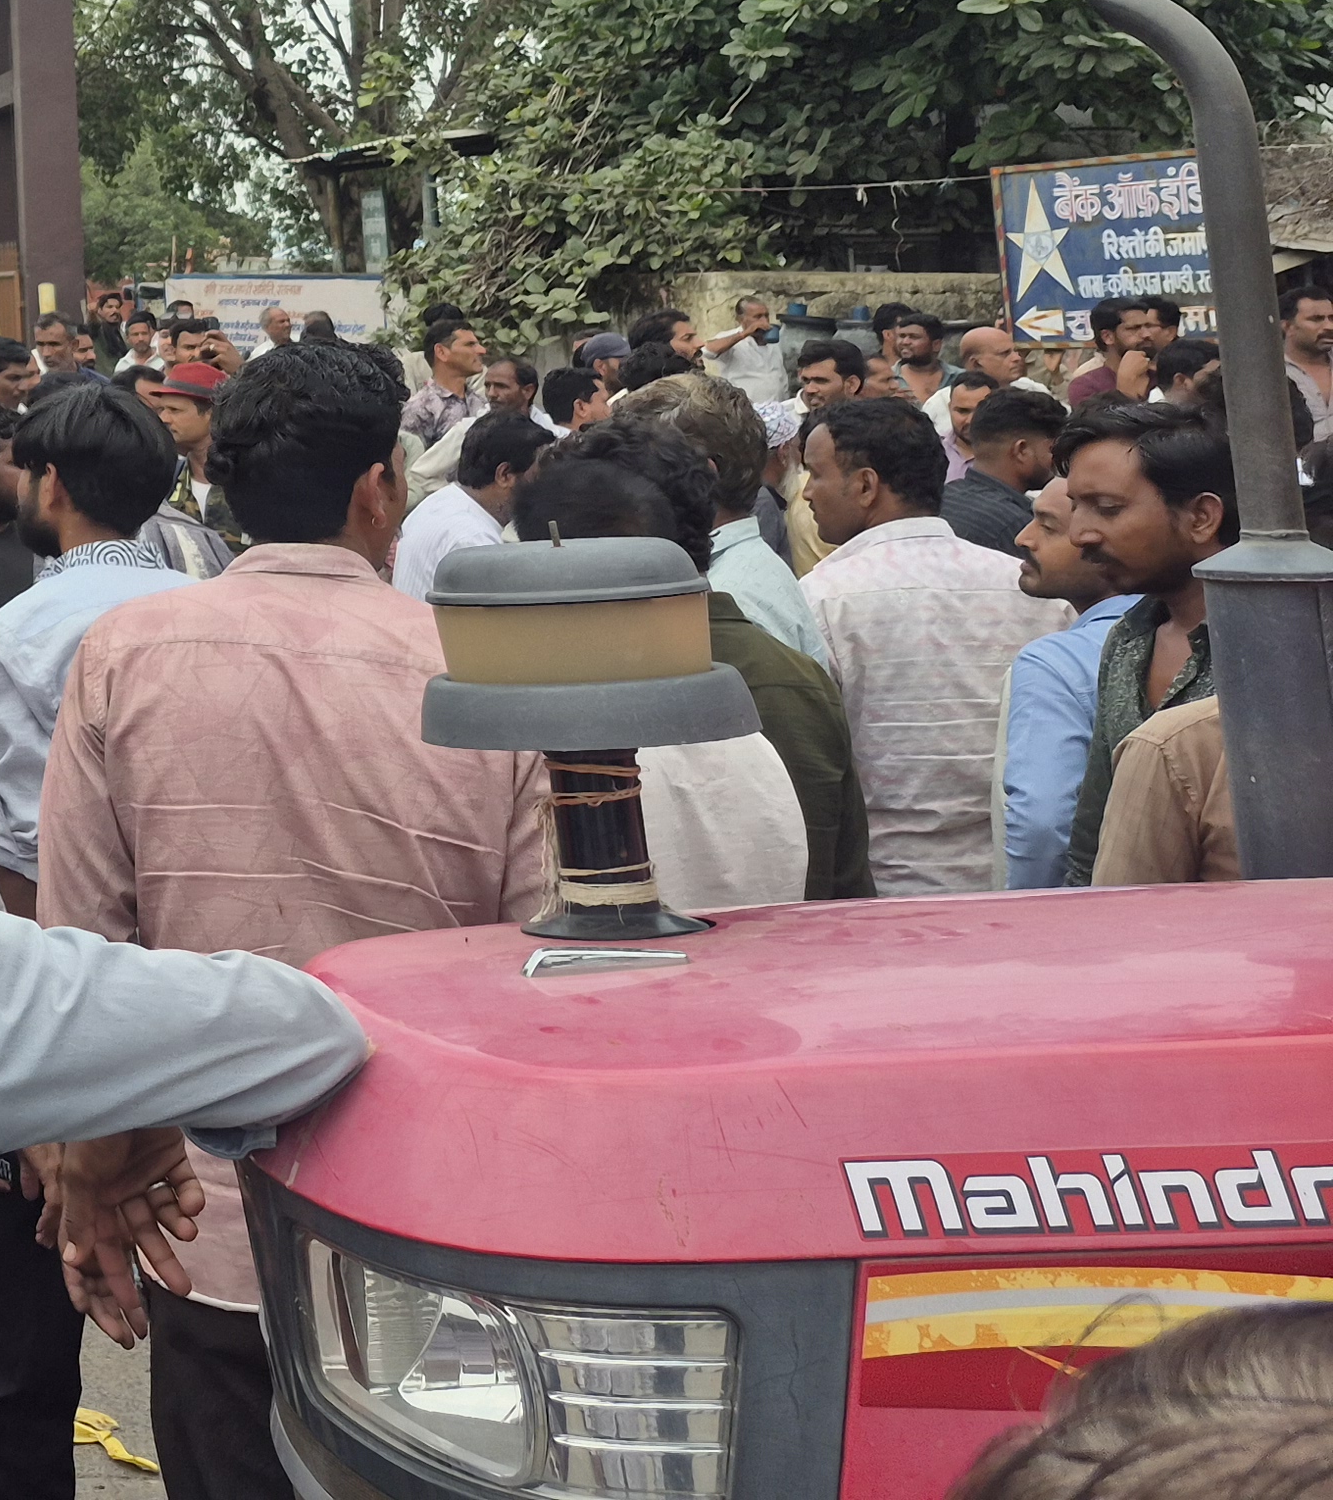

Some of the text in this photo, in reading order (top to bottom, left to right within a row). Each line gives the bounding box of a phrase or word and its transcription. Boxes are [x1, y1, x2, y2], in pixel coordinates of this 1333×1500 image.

[1053, 171, 1102, 222] बैंक
[1159, 162, 1204, 220] इंडि
[843, 1149, 1333, 1236] Mahindr
